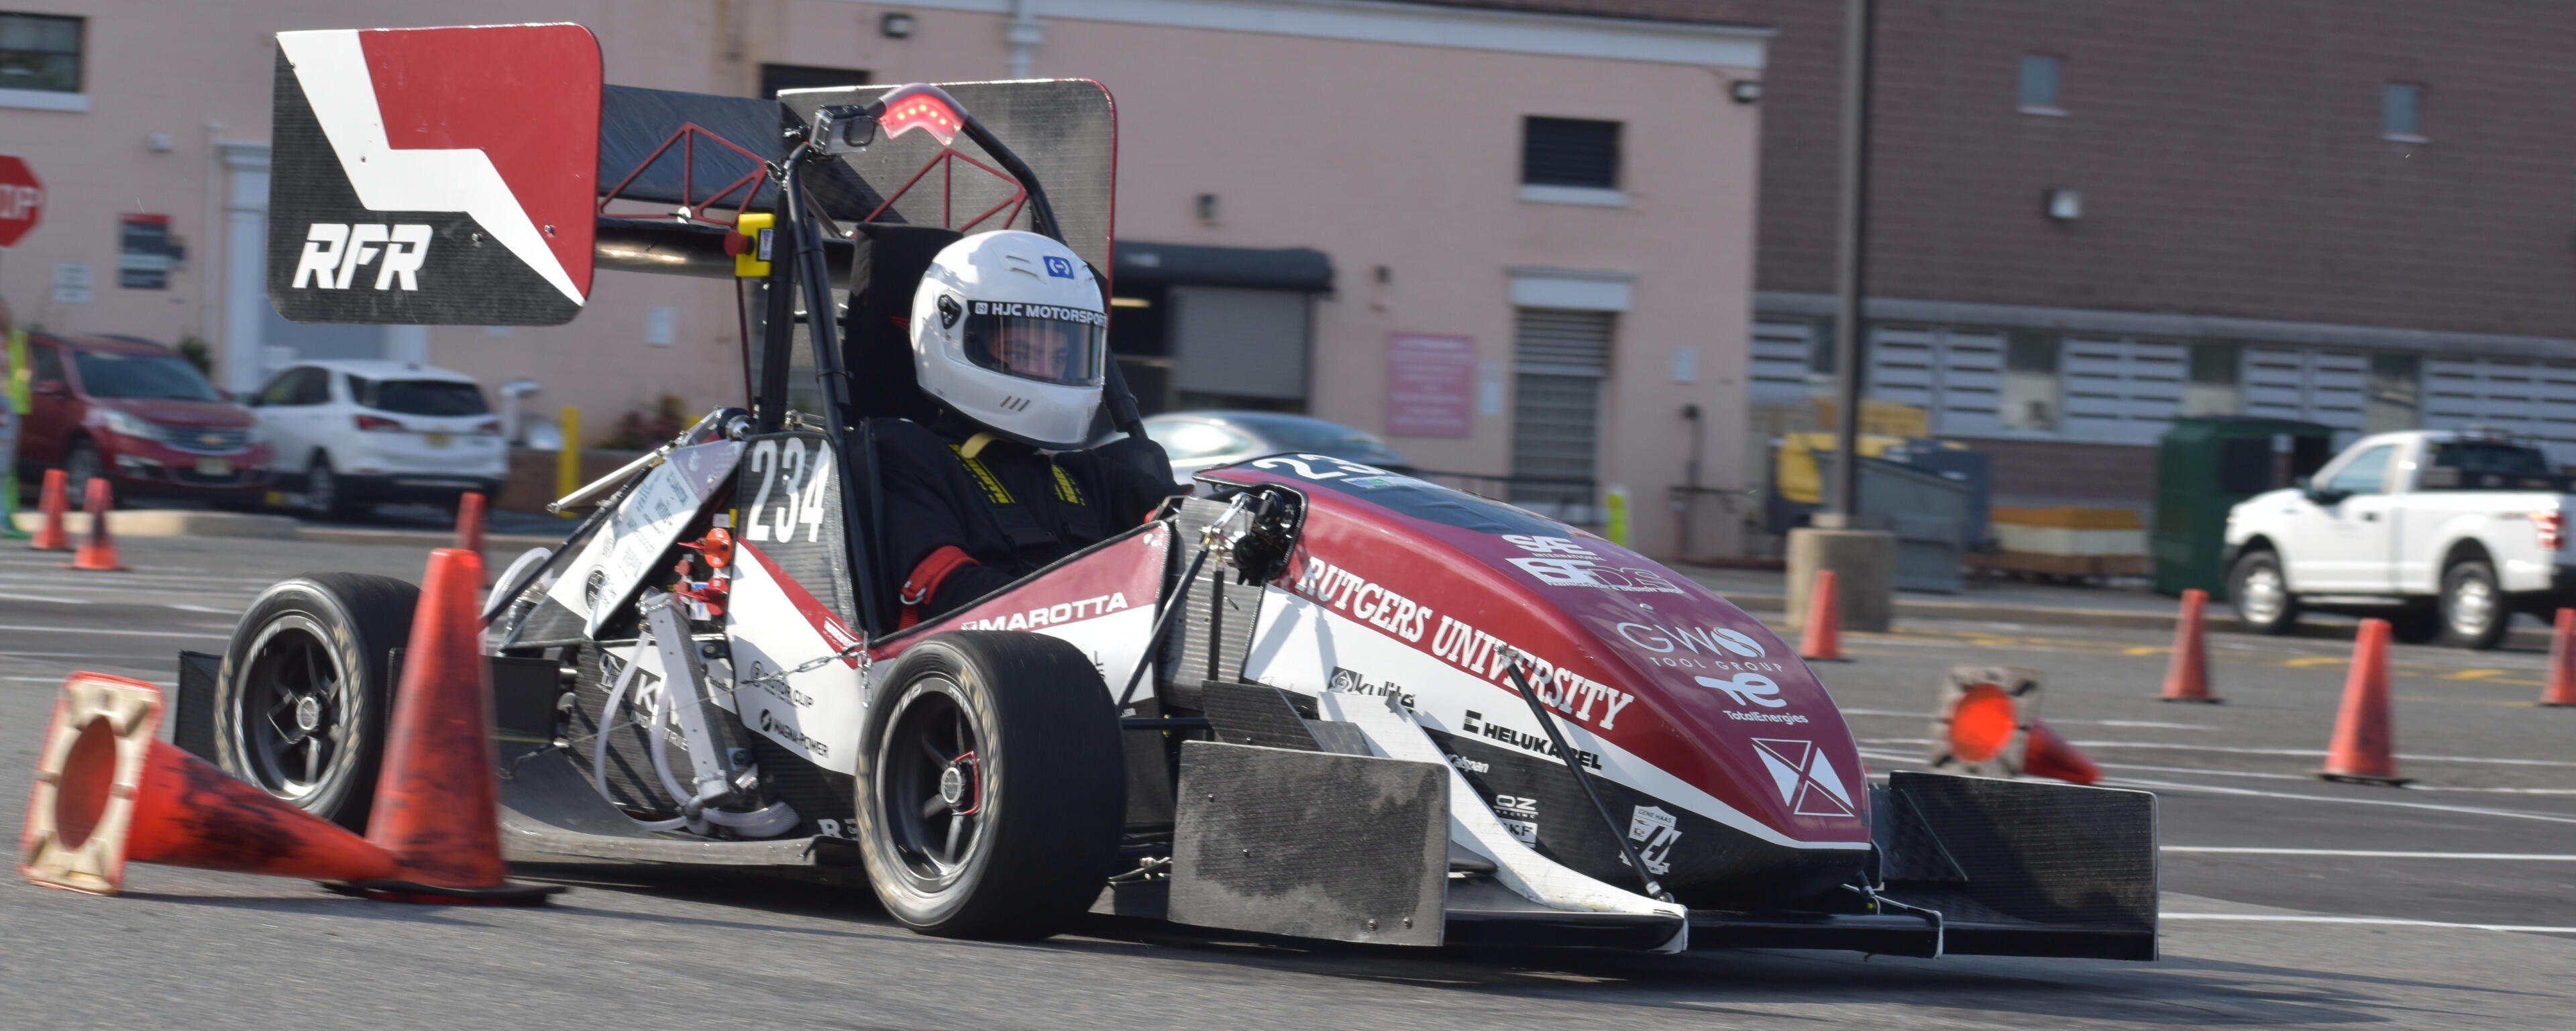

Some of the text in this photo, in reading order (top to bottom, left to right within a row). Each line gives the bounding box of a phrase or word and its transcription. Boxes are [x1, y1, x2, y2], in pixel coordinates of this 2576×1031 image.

[292, 223, 433, 291] RFR
[991, 303, 1023, 316] HJC
[746, 437, 831, 543] 234
[1502, 534, 1597, 557] SAE
[979, 592, 1128, 631] MAROTTA
[1294, 556, 1635, 730] RUTGERS UNIVERSITY
[1649, 657, 1782, 671] TOOL GROUP
[1722, 710, 1809, 725] TotalEnergies
[1496, 794, 1538, 811] OZ
[1502, 822, 1534, 836] KF
